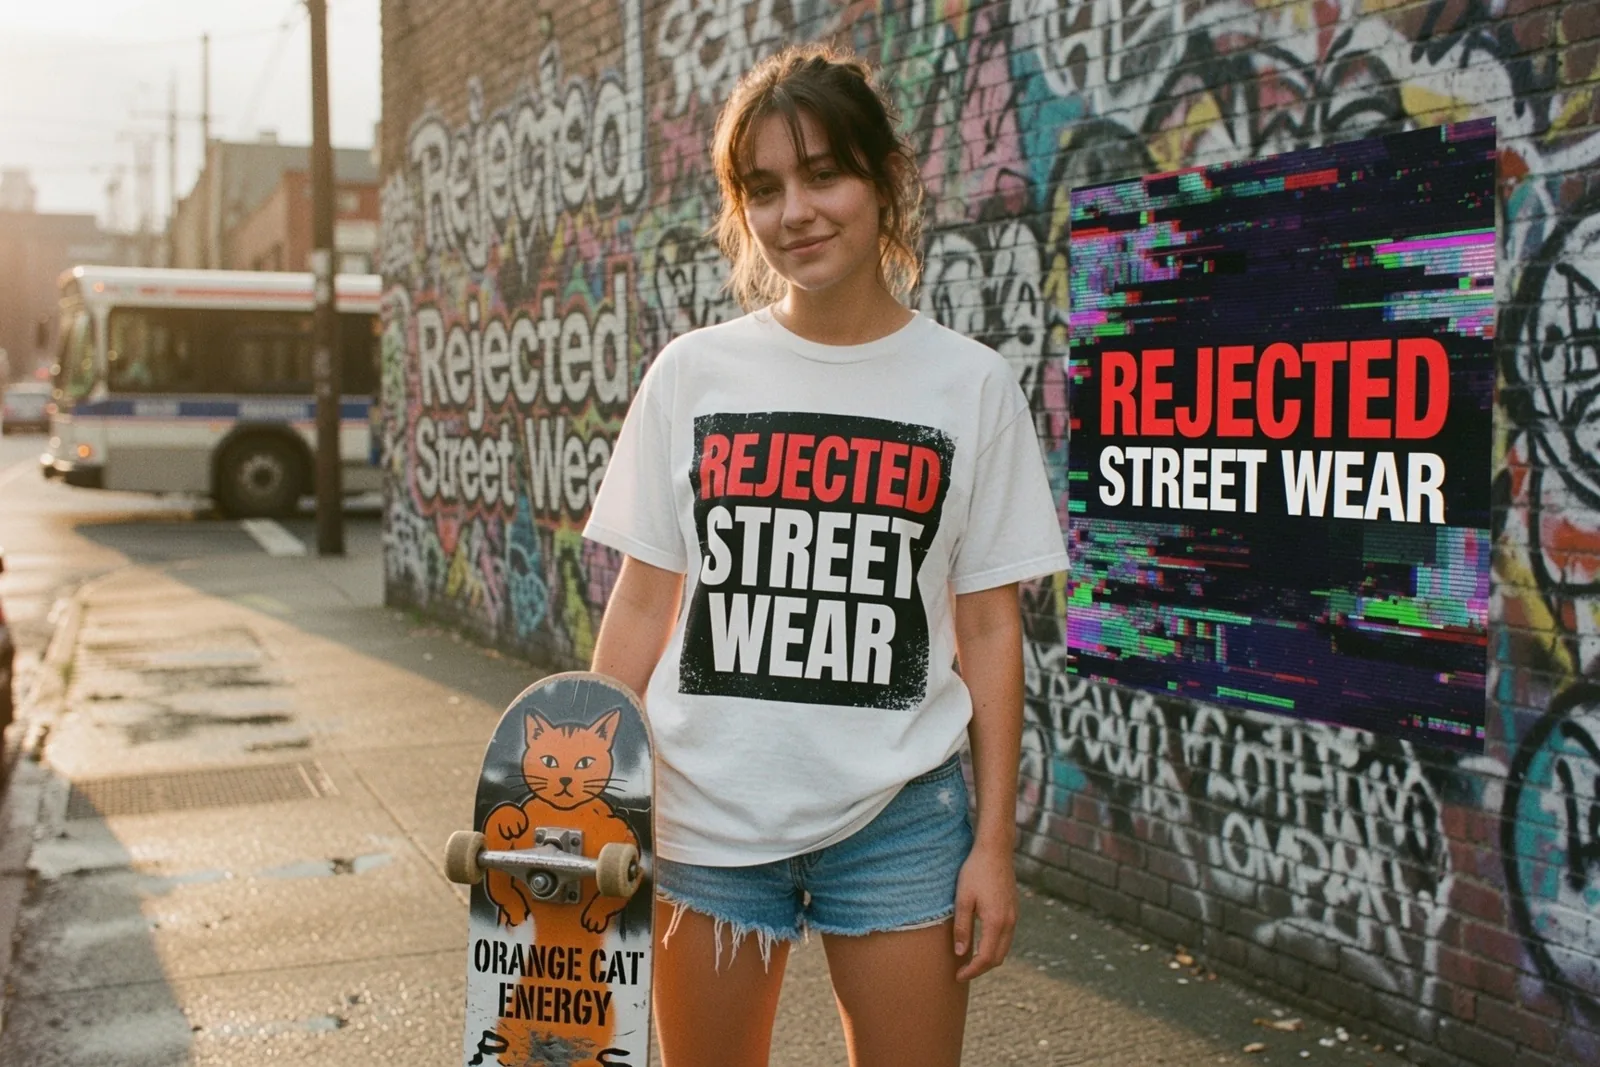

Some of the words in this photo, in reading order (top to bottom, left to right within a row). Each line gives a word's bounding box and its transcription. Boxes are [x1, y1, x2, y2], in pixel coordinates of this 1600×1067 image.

[417, 274, 629, 430] Rejected
[1100, 337, 1450, 440] REJECTED
[415, 416, 517, 502] Street
[524, 416, 615, 511] Wea
[699, 432, 942, 514] REJECTED
[1098, 445, 1268, 514] STREET
[1281, 449, 1447, 525] WEAR
[700, 505, 925, 600] STREET
[708, 592, 897, 686] WEAR
[474, 938, 583, 982] ORANGE
[589, 948, 645, 986] CAT
[498, 982, 613, 1027] ENERGY
